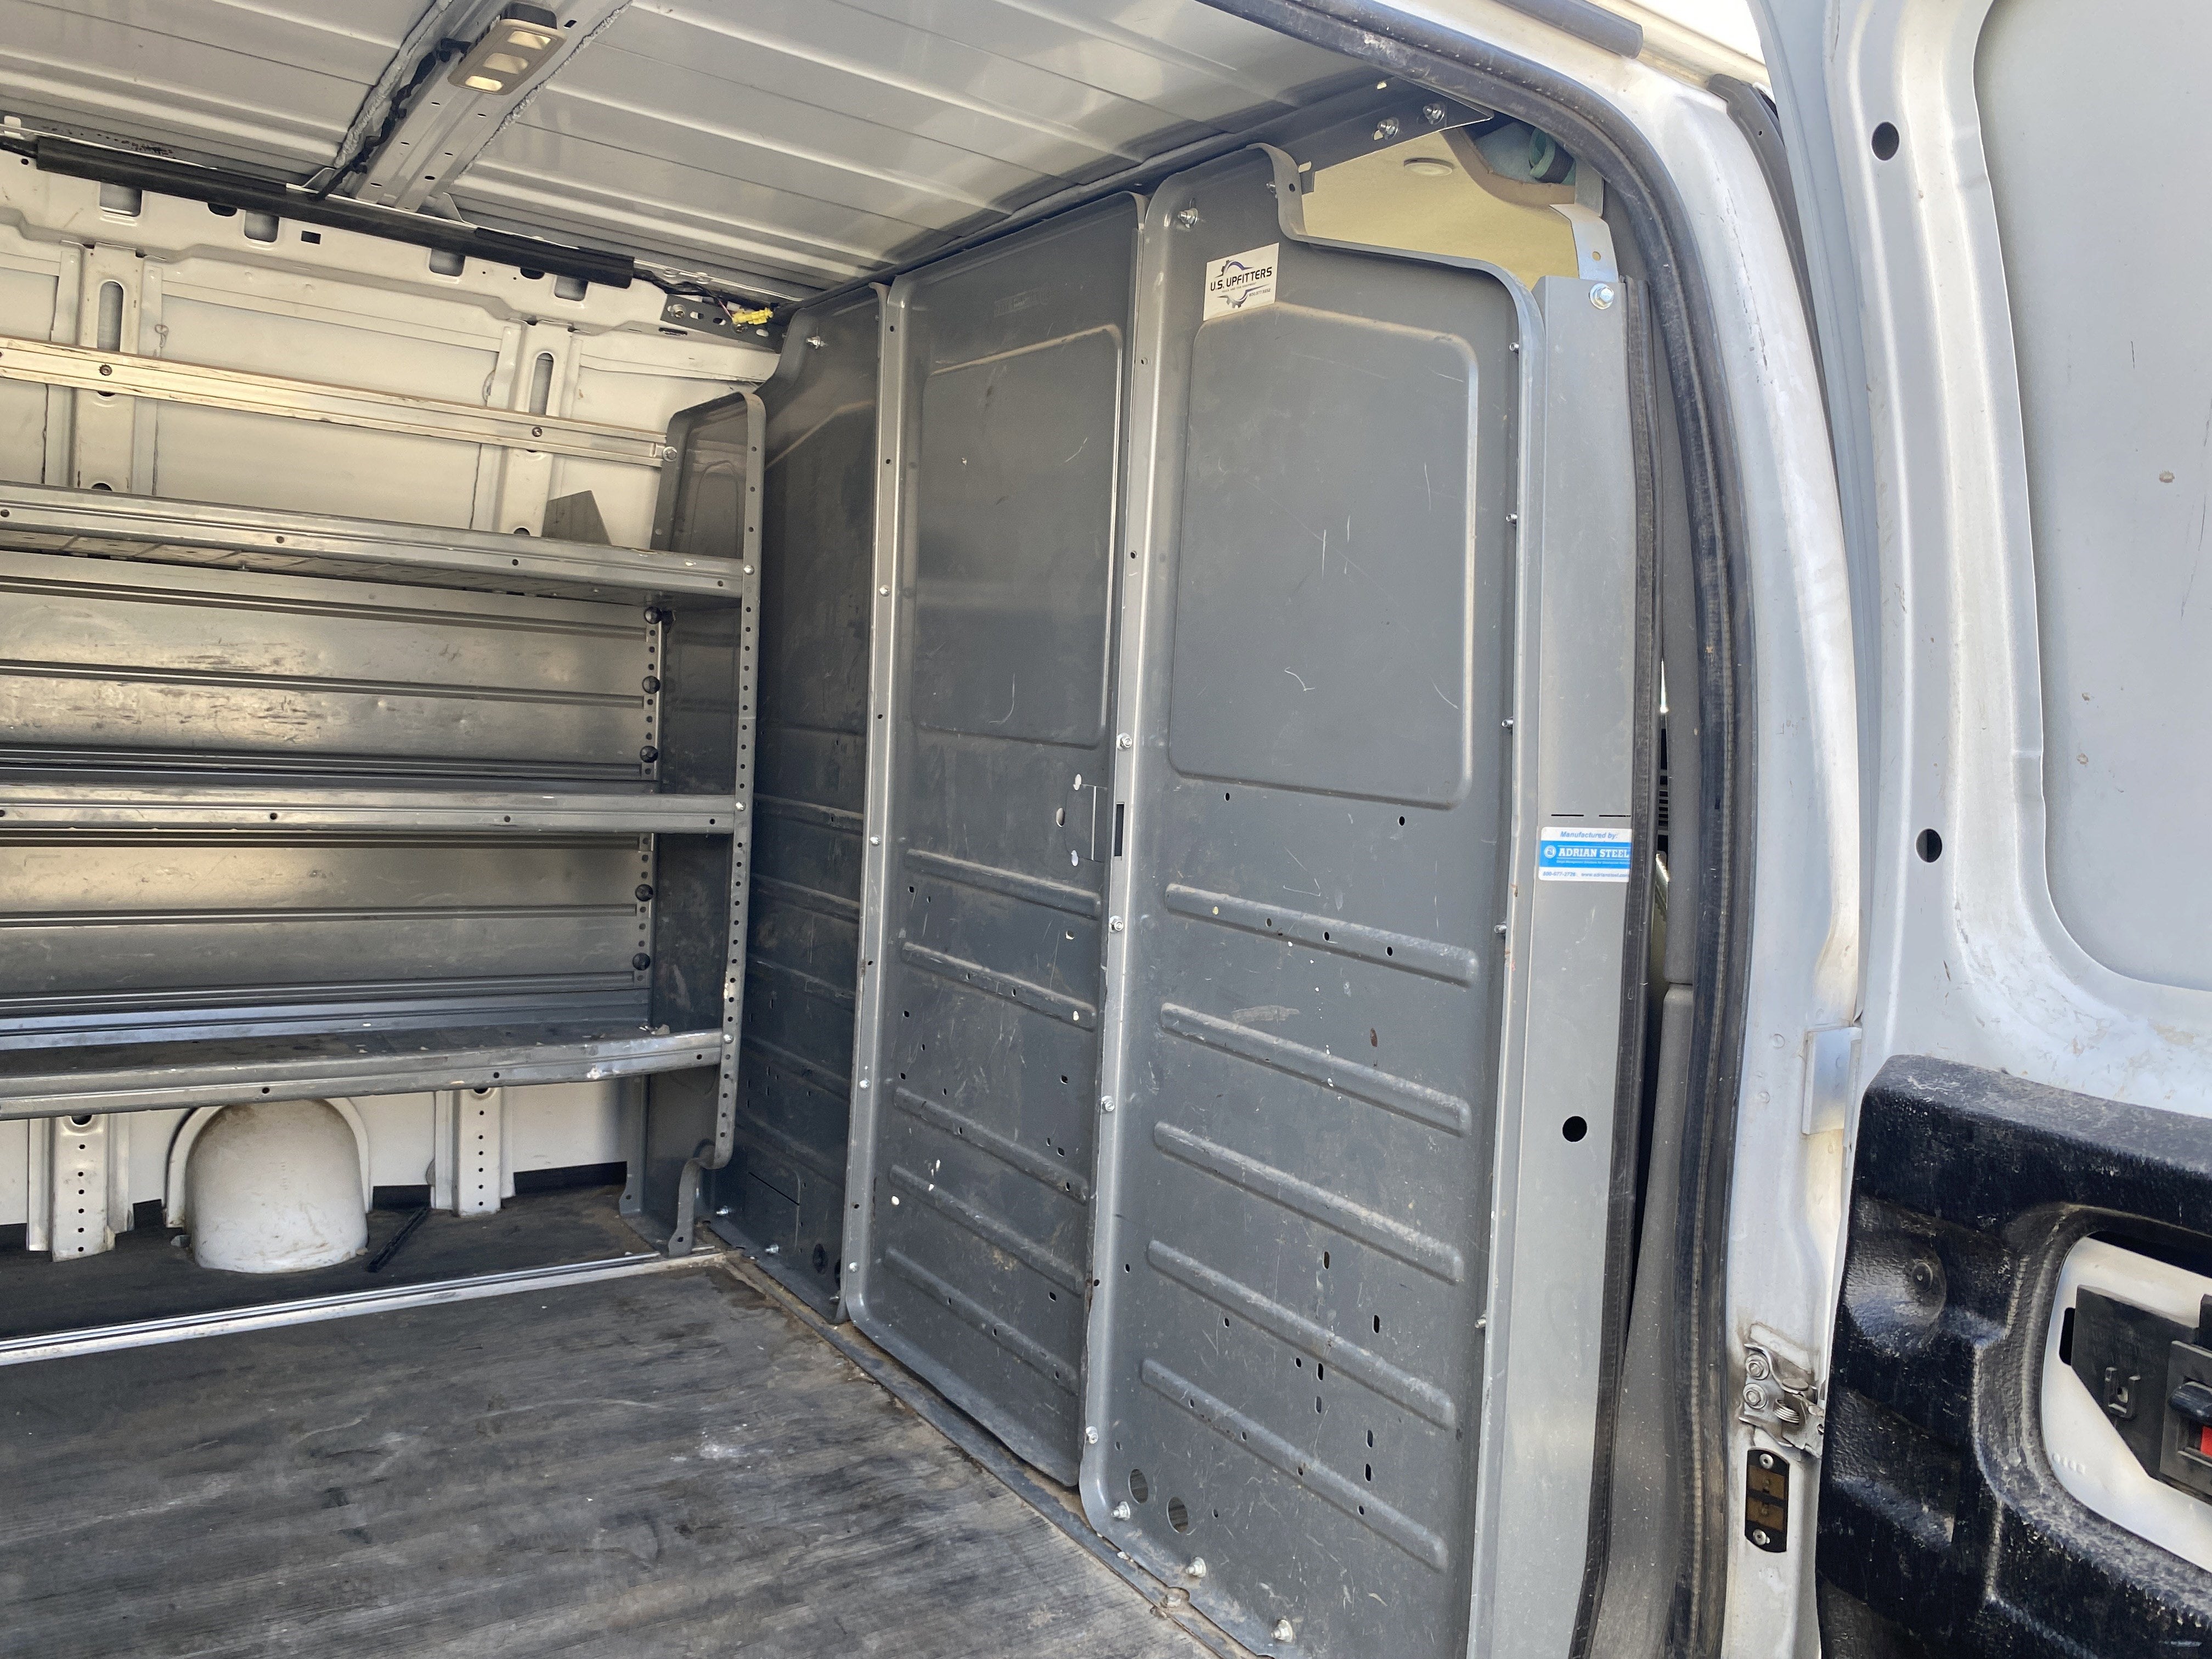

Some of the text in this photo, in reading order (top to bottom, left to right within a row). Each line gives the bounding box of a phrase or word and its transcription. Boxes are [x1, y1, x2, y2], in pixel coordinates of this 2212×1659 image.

[1210, 267, 1272, 291] U.S. UPFITTERS
[1560, 831, 1607, 839] Manufactured
[1559, 848, 1629, 858] ADRIAN STEEL
